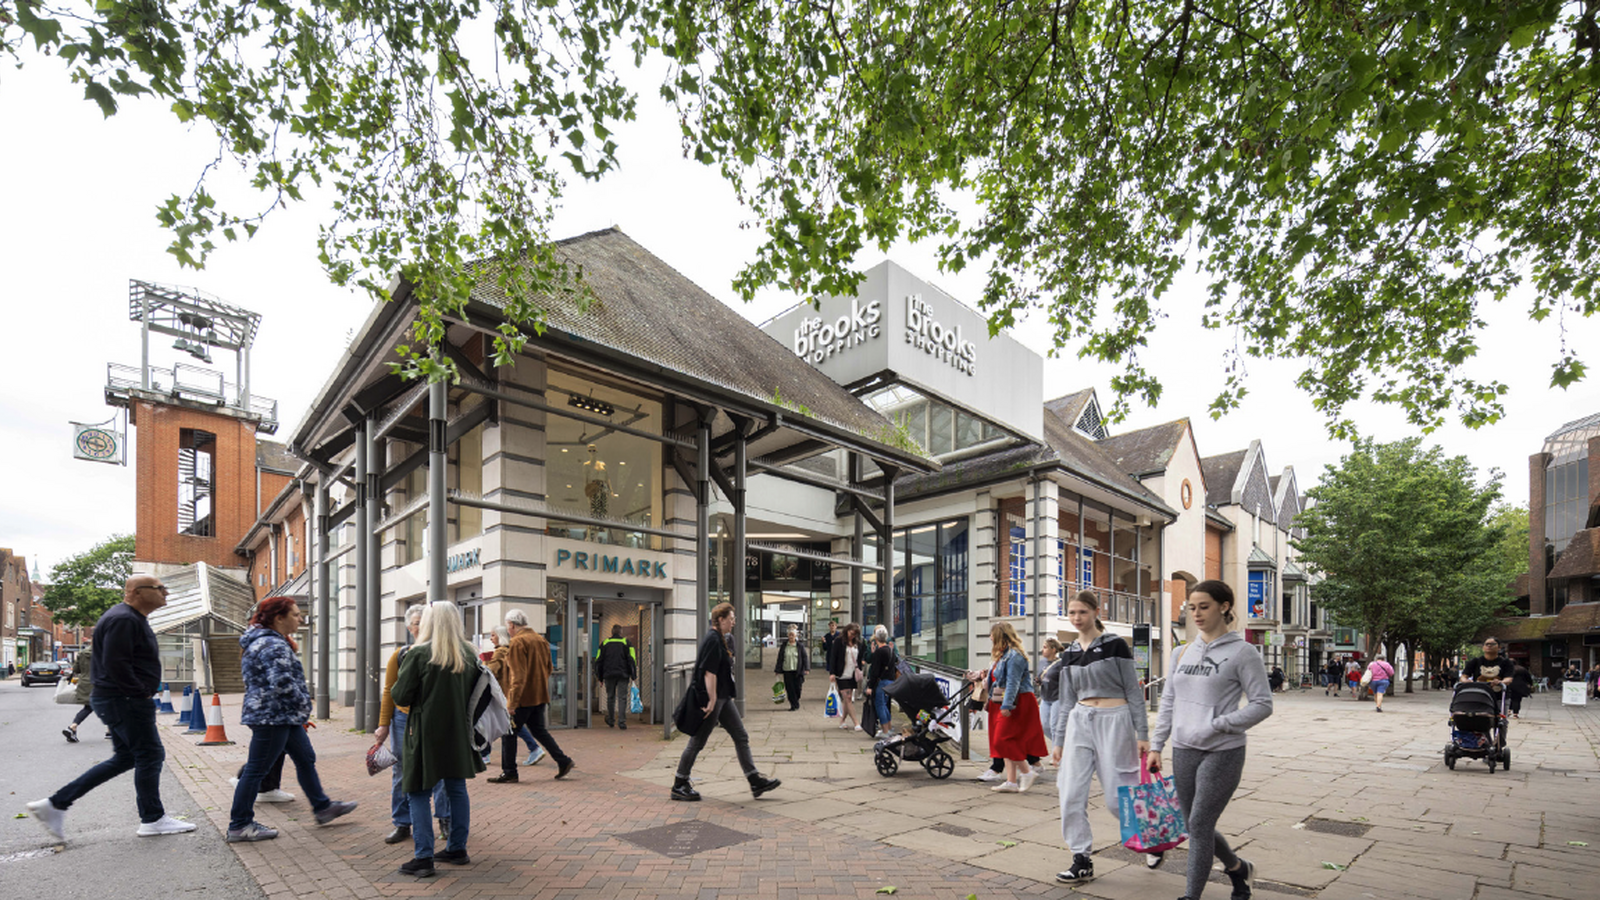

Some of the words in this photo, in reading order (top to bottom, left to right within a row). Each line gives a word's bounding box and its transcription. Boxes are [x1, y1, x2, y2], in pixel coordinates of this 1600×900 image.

[909, 293, 933, 317] the
[794, 299, 881, 358] brooks
[800, 317, 823, 336] the
[905, 294, 976, 363] brooks
[905, 330, 976, 377] SHOPPING
[557, 548, 668, 578] PRIMARK
[1177, 664, 1213, 677] PUMA
